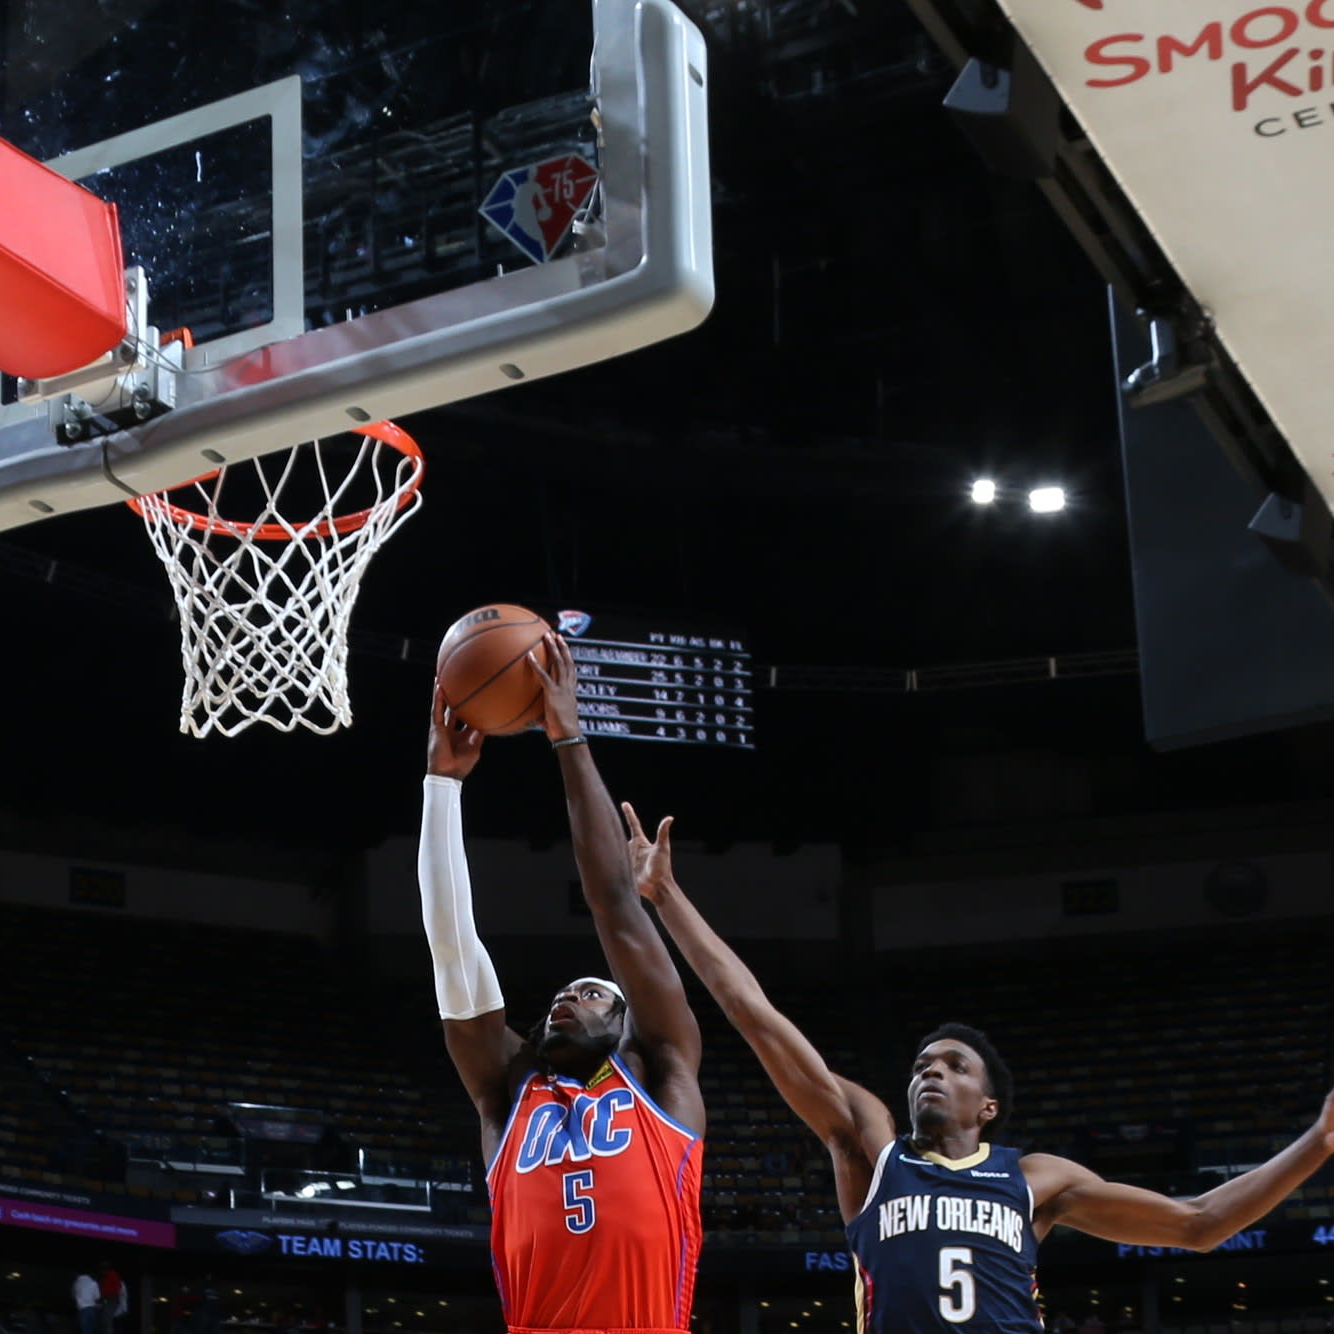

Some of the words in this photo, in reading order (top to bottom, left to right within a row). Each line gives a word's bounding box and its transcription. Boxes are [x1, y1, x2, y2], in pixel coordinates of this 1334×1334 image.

[516, 1087, 635, 1174] OKC
[562, 1169, 596, 1235] 5
[879, 1195, 931, 1242] NEW
[936, 1196, 1024, 1254] ORLEANS
[278, 1234, 342, 1258] TEAM
[349, 1240, 425, 1264] STATS:
[938, 1247, 976, 1323] 5
